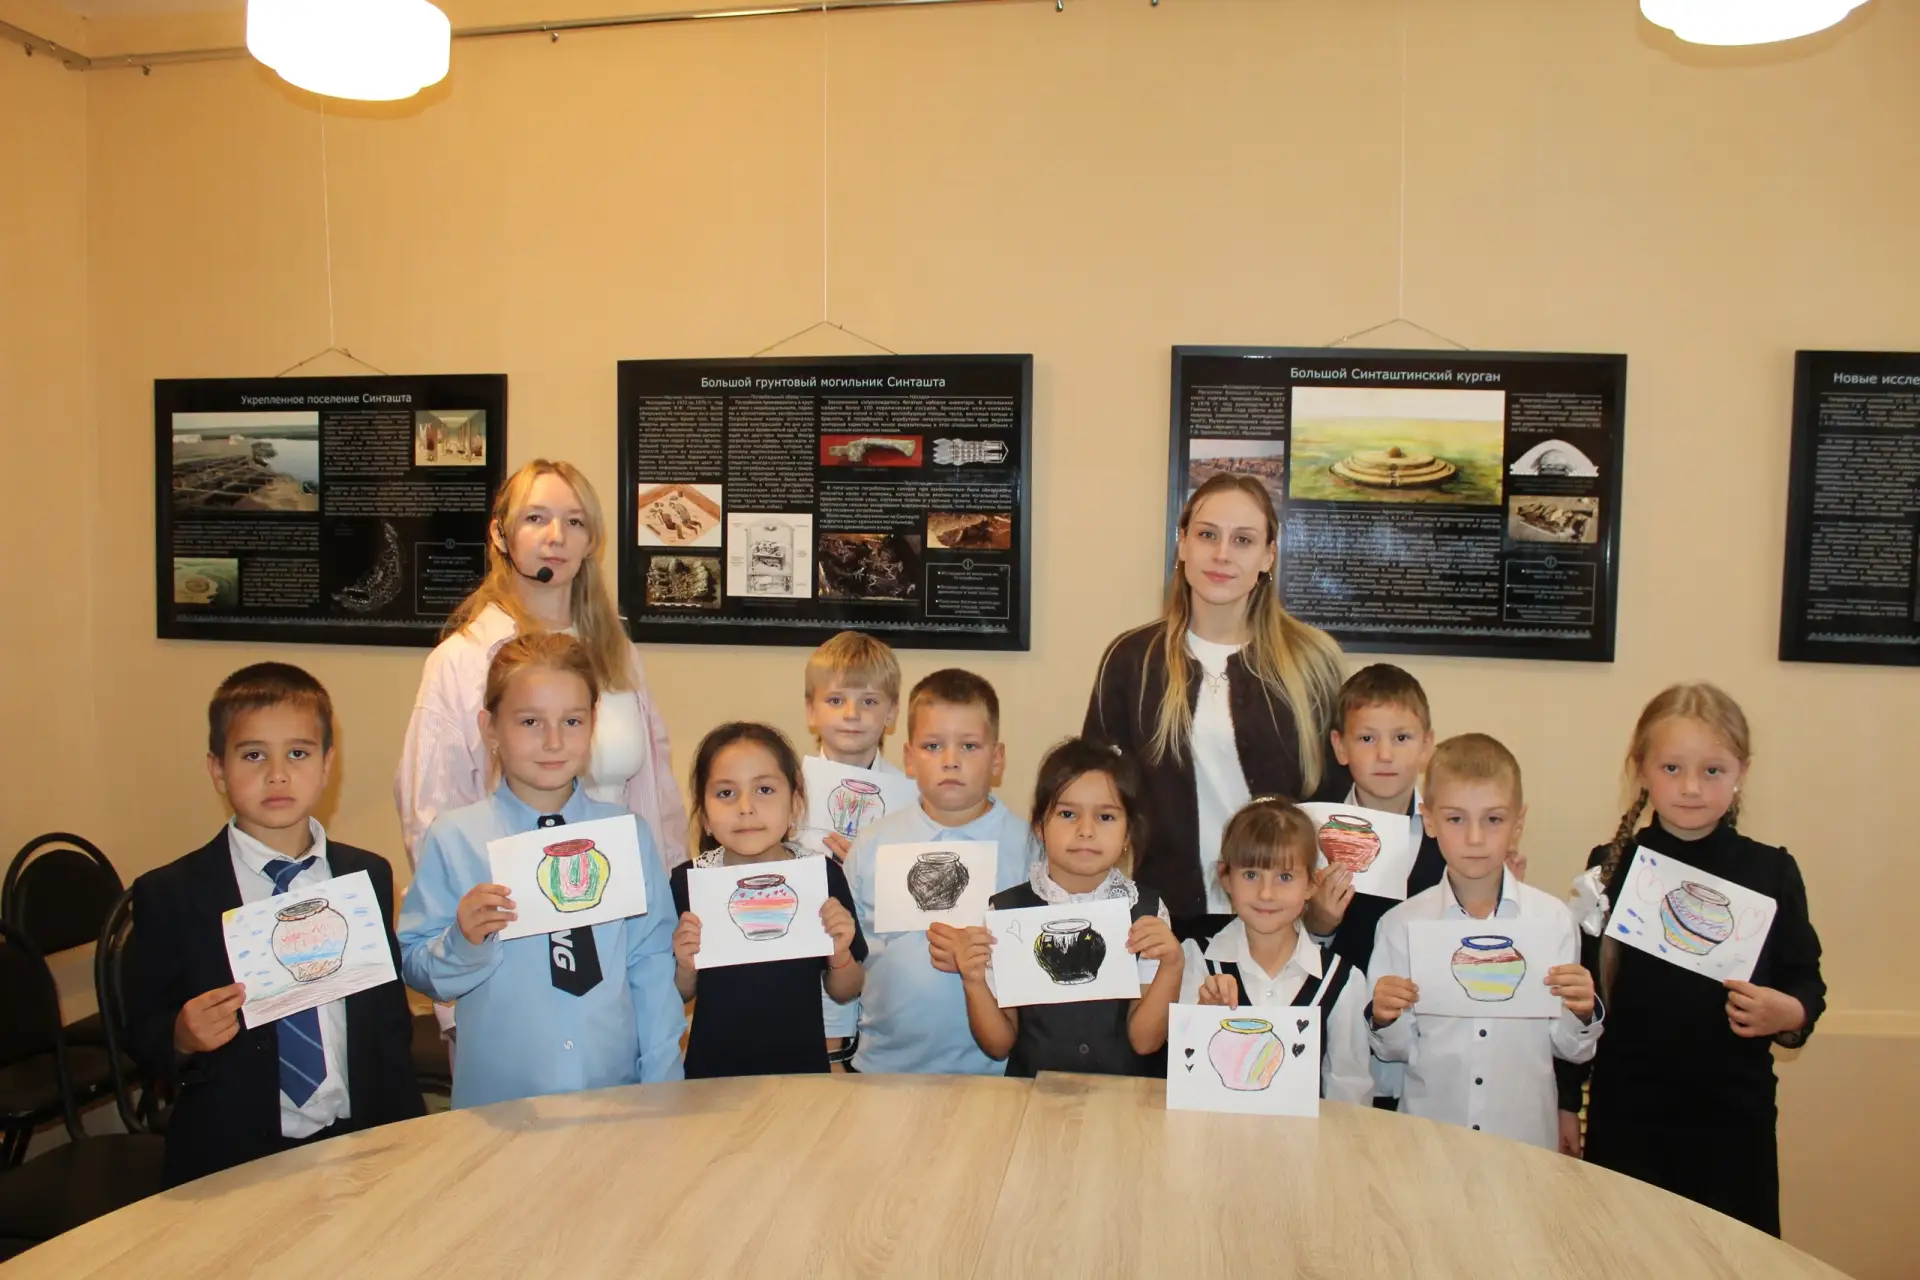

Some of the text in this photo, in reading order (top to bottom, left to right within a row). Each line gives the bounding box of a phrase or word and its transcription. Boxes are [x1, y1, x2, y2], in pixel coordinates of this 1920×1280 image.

[1290, 367, 1501, 383] Большой Синташтинский курган
[1833, 372, 1878, 384] Новые
[701, 376, 946, 389] Большой грунтовый могильник Синташта
[240, 392, 412, 407] Укрепленное поселение Синташта
